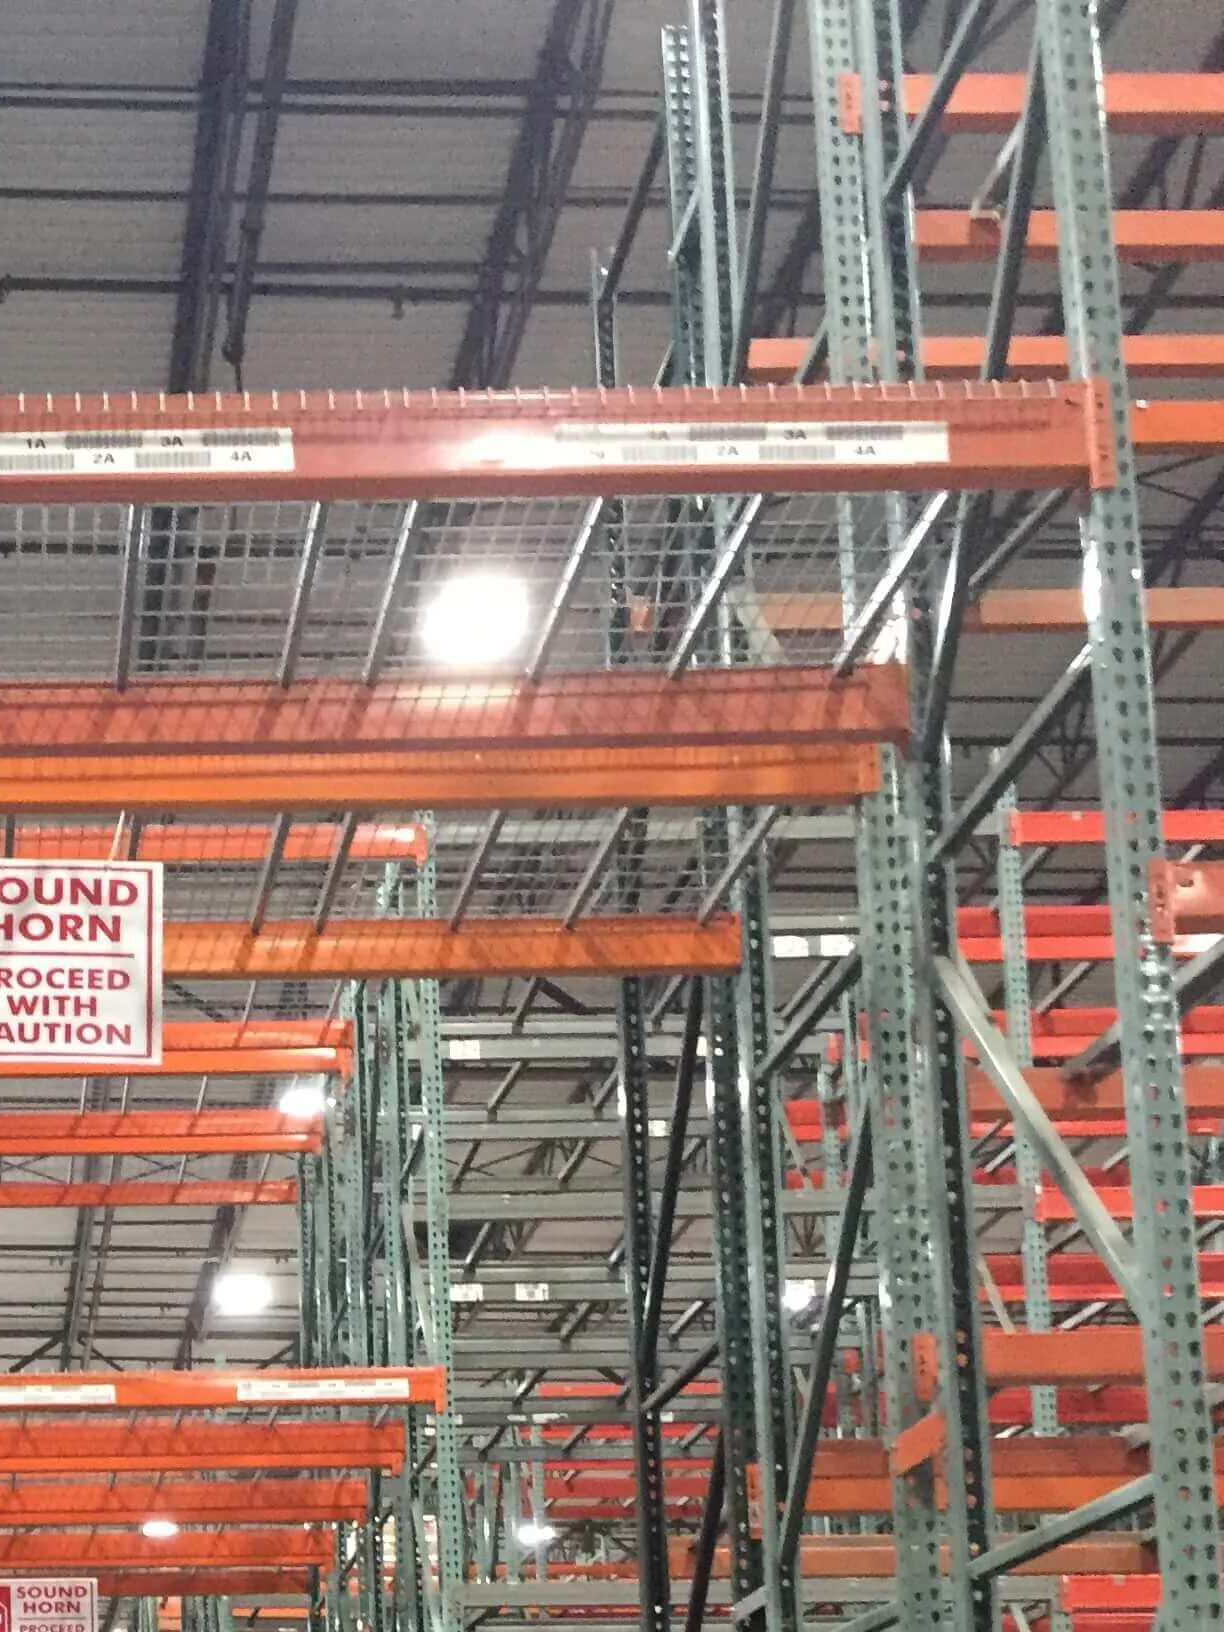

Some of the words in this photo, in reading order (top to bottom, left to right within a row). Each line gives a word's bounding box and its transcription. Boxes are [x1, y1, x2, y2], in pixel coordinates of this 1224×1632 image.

[784, 429, 807, 440] 3A
[25, 438, 46, 449] 1A
[159, 436, 184, 447] 3A
[853, 446, 876, 455] 4A
[92, 453, 115, 464] 2A
[230, 451, 252, 462] 4A
[7, 995, 97, 1017] WITH
[16, 1585, 88, 1599] SOUND
[23, 1601, 81, 1614] HORN
